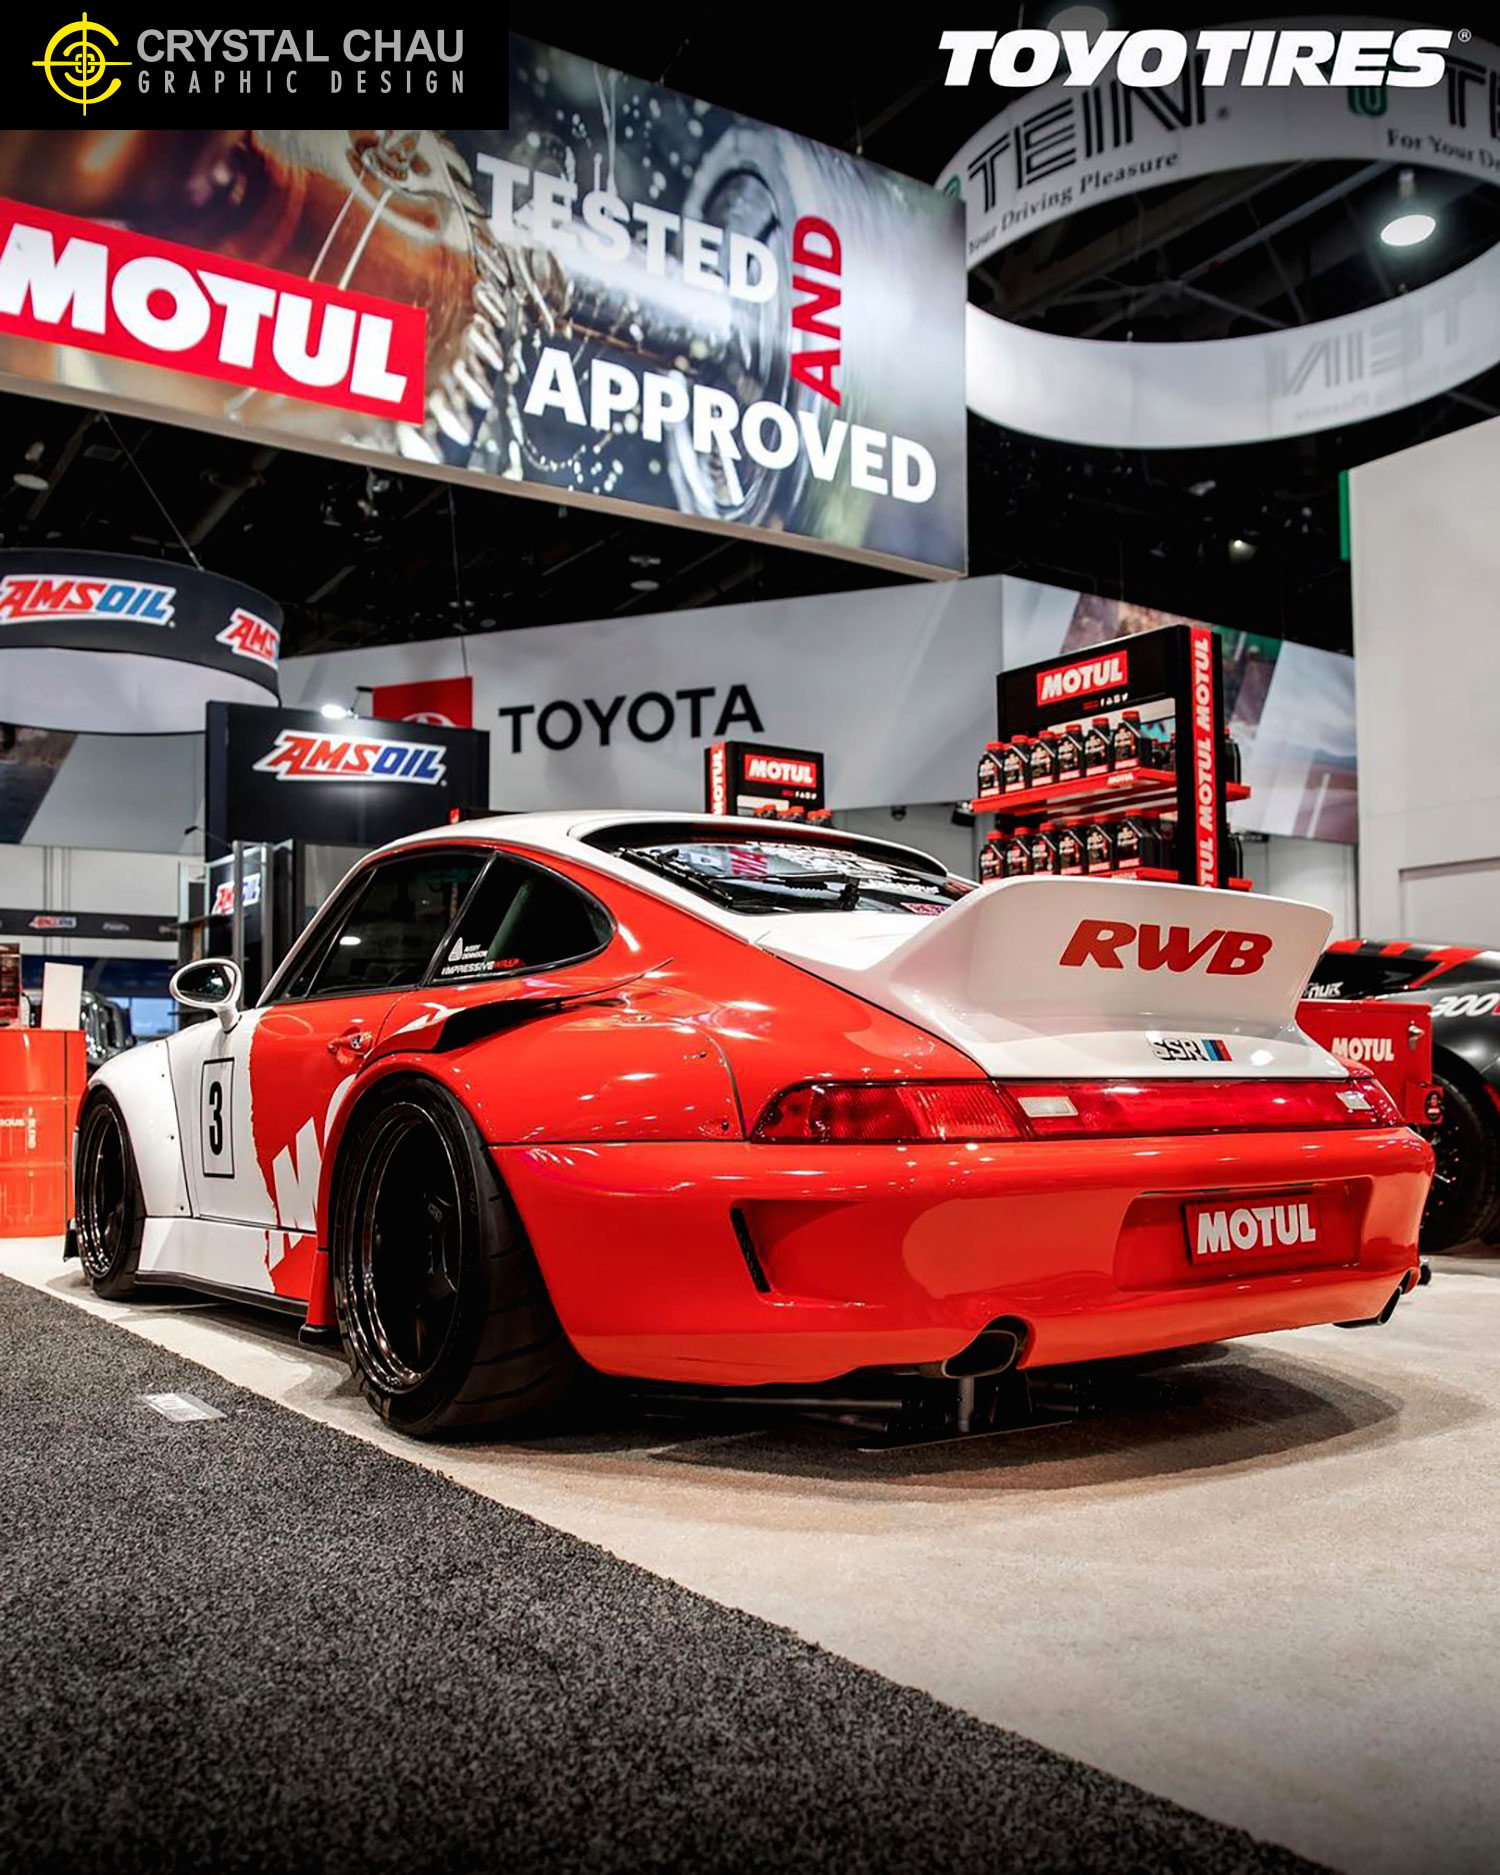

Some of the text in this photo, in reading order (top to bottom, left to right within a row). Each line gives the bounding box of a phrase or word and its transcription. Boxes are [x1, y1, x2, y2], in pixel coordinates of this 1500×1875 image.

[967, 56, 1207, 213] TEIN
[1386, 128, 1422, 149] For
[1428, 134, 1474, 163] Your
[476, 152, 779, 304] TESTED
[1001, 186, 1074, 233] Driving
[1079, 152, 1179, 195] Pleasure
[0, 222, 408, 404] MOTUL
[789, 214, 843, 407] AND
[523, 346, 937, 504] APPROVED
[0, 578, 174, 623] AMSOIL
[224, 612, 279, 662] AMS
[1041, 656, 1124, 701] MOTUL
[1194, 637, 1209, 732] MOTUL
[498, 683, 765, 754] TOYOTA
[264, 734, 446, 781] AMSOIL
[749, 759, 812, 783] MOTUL
[1195, 741, 1214, 831] MOTUL
[1058, 919, 1272, 975] RWB
[1331, 1037, 1395, 1062] MOTUL
[208, 1080, 224, 1156] 3
[1196, 1203, 1317, 1254] MOTUL
